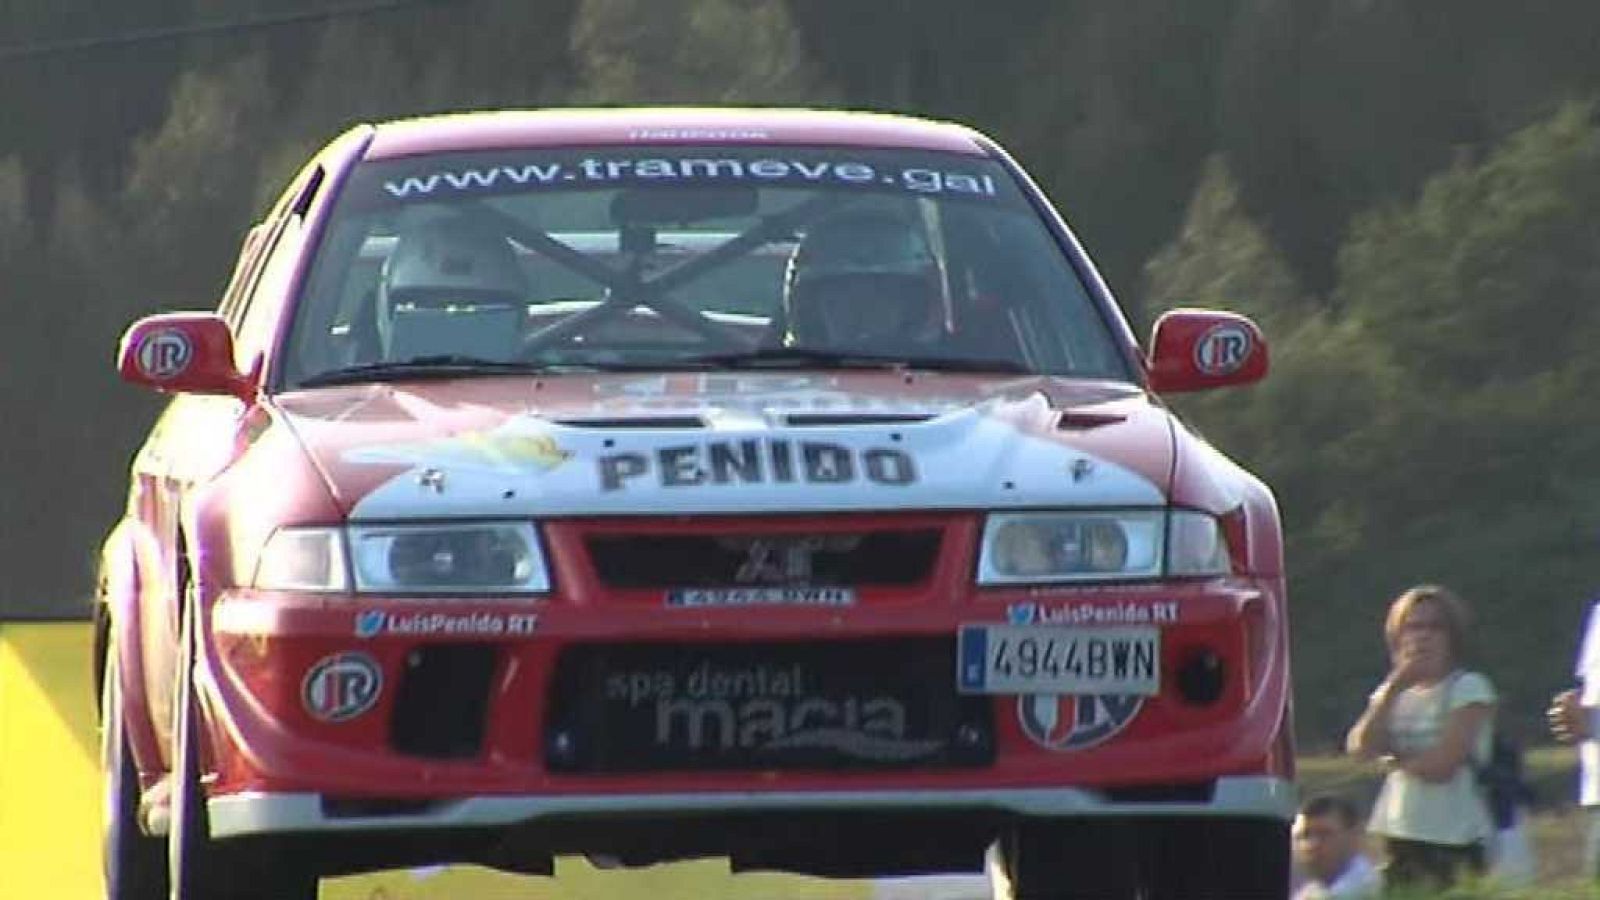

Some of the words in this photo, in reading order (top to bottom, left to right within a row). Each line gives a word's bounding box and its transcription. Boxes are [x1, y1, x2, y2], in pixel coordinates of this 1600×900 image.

[599, 439, 918, 491] PENIDO
[387, 613, 504, 634] LuisPenido
[507, 613, 537, 634] RT
[1039, 603, 1149, 622] LuisPenido
[1152, 602, 1178, 622] RT
[993, 638, 1155, 681] 4944BWN
[606, 672, 676, 705] spa
[688, 661, 801, 696] dental
